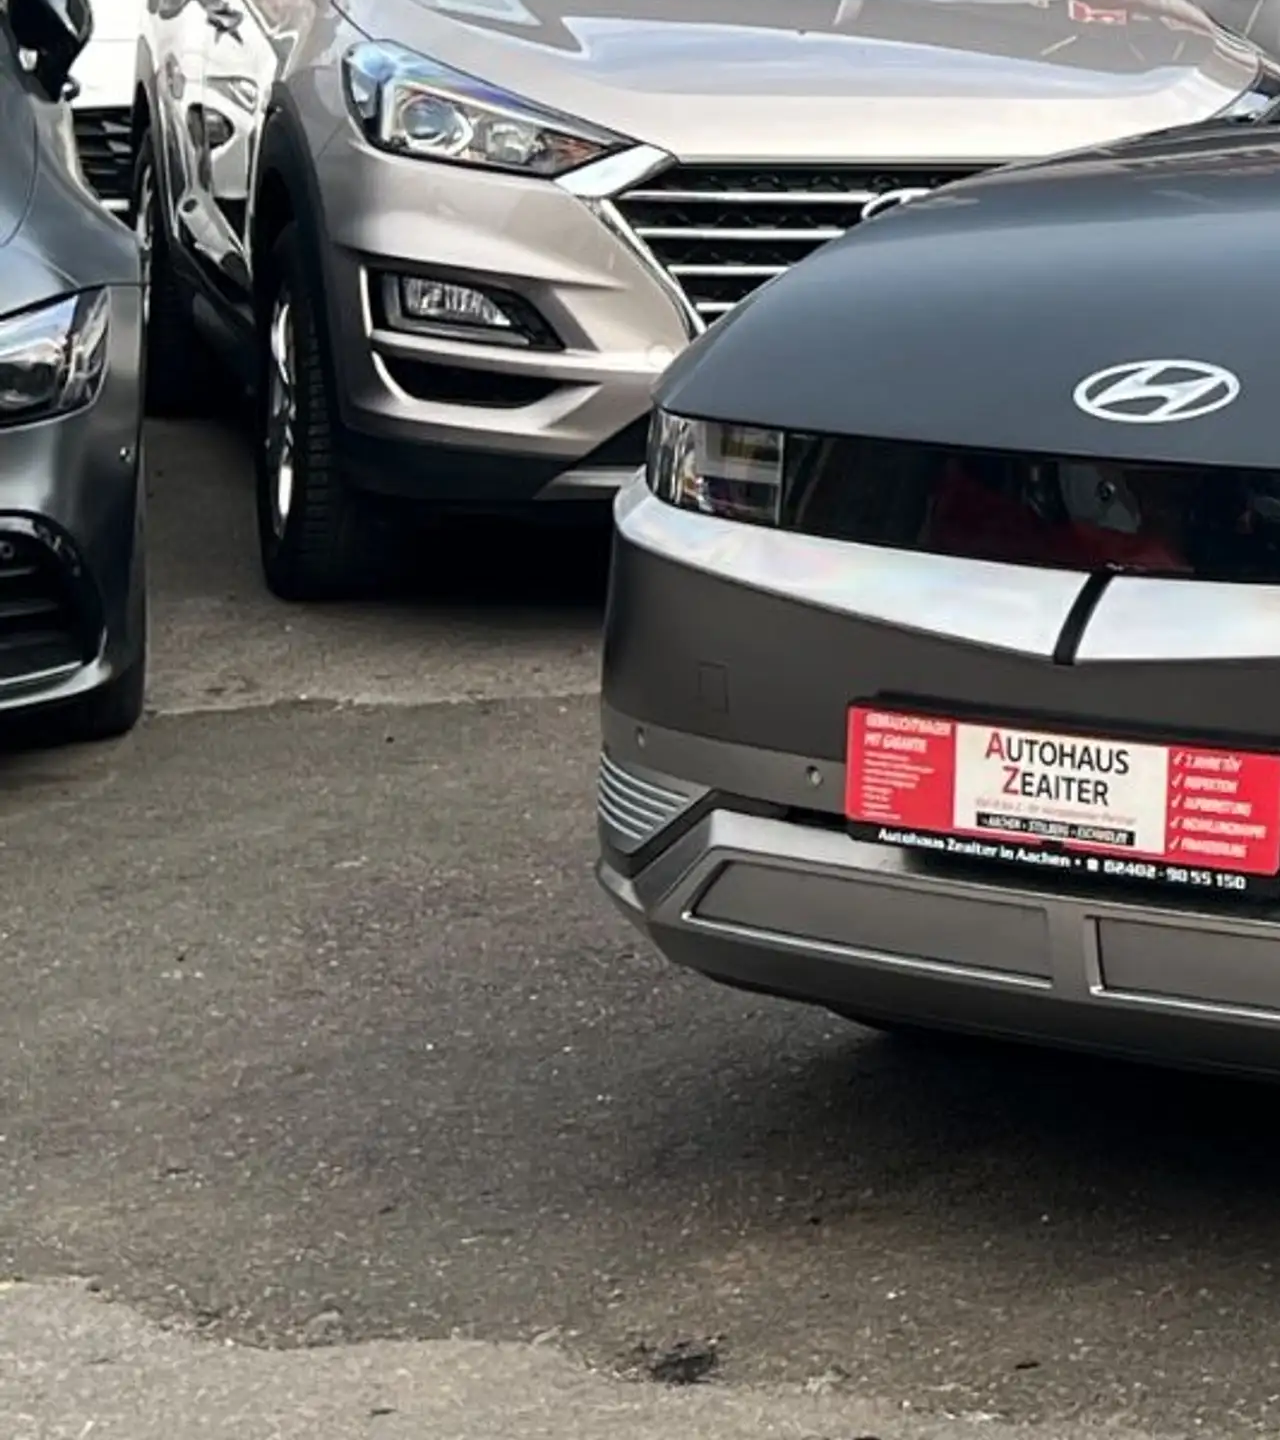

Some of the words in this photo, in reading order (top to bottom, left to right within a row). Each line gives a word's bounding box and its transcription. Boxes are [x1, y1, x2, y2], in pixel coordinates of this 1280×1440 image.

[985, 732, 1129, 775] AUTOHAUS
[1002, 766, 1109, 806] ZEAITER
[878, 828, 944, 849] Autohaus
[948, 838, 998, 858] Zeaiter
[1016, 847, 1071, 867] Aachen
